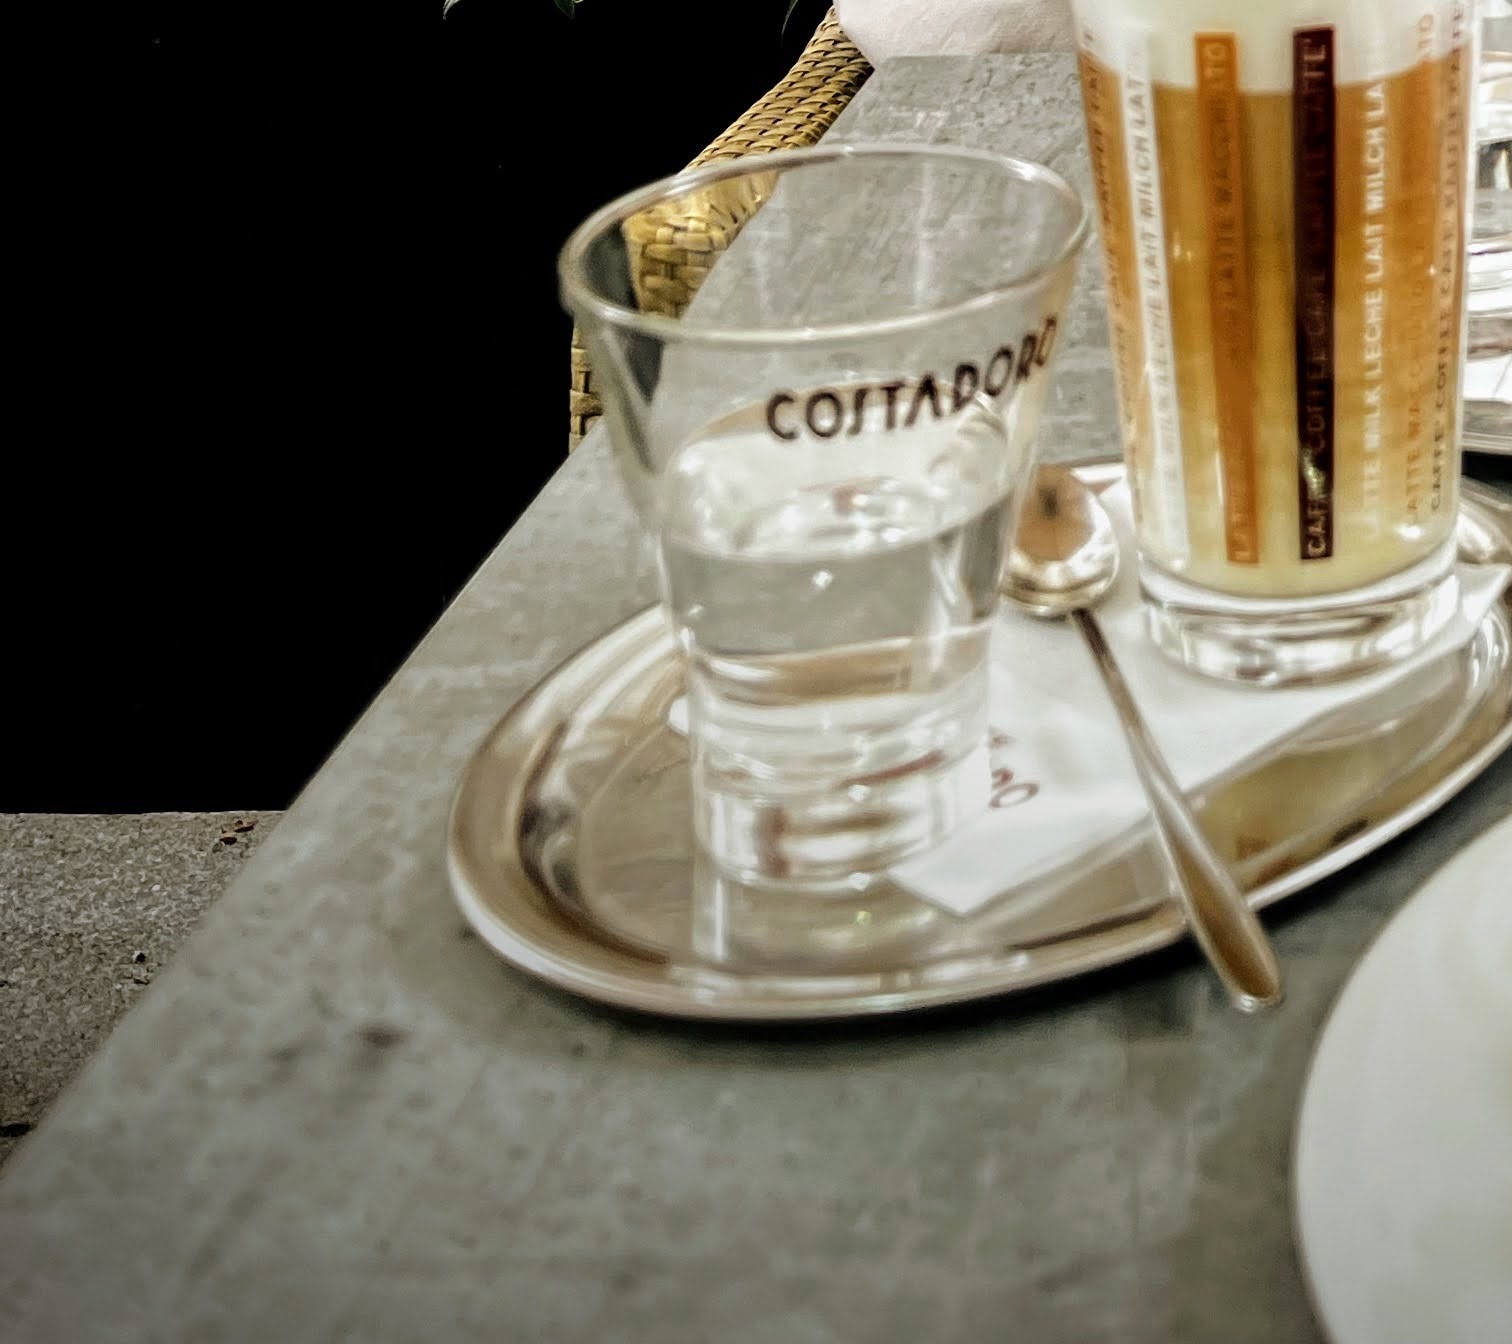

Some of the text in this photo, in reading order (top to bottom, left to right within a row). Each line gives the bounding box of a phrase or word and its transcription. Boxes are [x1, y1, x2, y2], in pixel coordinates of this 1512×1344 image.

[1365, 127, 1385, 214] MILCH
[1365, 223, 1385, 282] LAIT
[1363, 291, 1384, 378] LECHE
[1363, 387, 1382, 450] MILK
